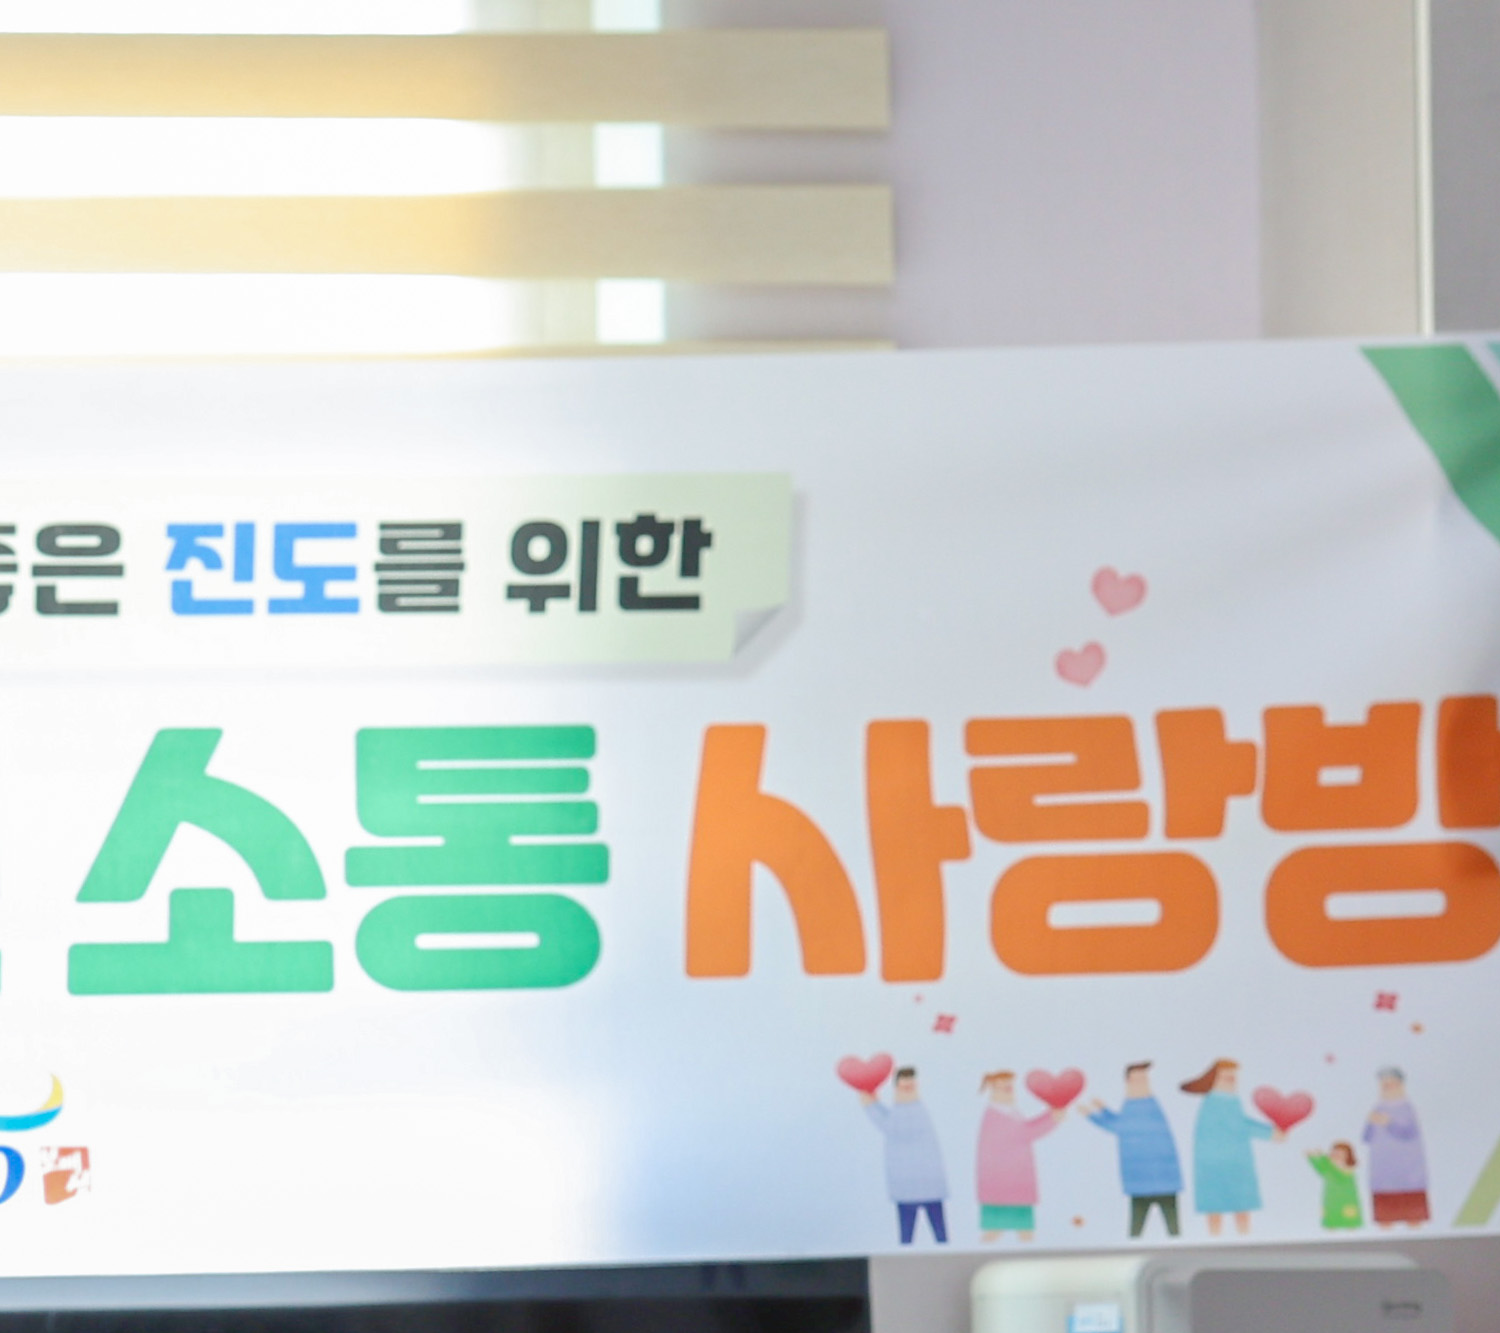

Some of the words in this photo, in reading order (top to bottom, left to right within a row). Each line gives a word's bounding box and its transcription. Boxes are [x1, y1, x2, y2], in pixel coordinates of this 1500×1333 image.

[164, 520, 466, 616] 진도를
[505, 512, 713, 614] 위한
[67, 724, 611, 995] 소통
